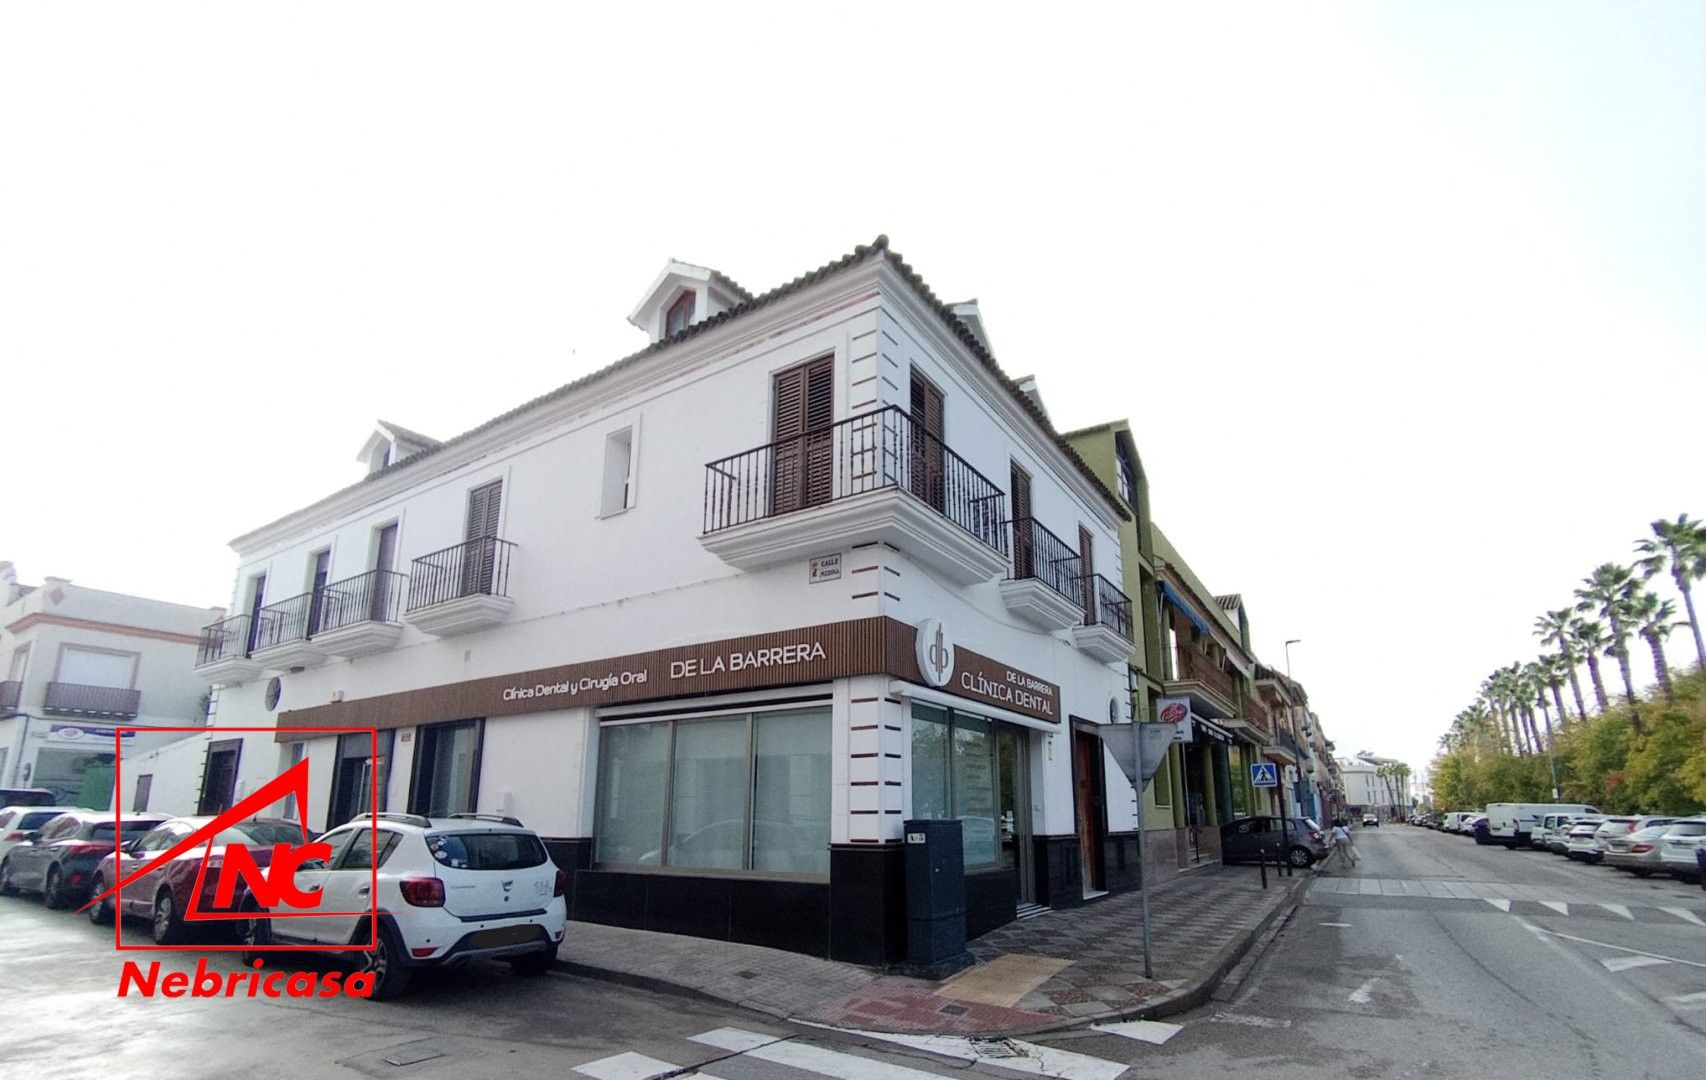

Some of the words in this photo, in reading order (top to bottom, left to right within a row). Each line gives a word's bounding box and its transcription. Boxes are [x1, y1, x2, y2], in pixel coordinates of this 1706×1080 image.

[820, 558, 839, 567] CALLE
[670, 659, 697, 679] DE
[700, 656, 726, 675] LA
[730, 641, 826, 671] BARRERA
[503, 684, 534, 701] Clínica
[535, 681, 569, 697] Dental
[570, 682, 579, 695] y
[579, 673, 619, 691] Cirugía
[620, 669, 648, 685] Oral
[961, 671, 1014, 703] CLÍNICA
[1015, 691, 1054, 715] DENTAL
[1006, 670, 1017, 684] DE
[1017, 674, 1026, 688] LA
[1026, 678, 1053, 697] BARRERA
